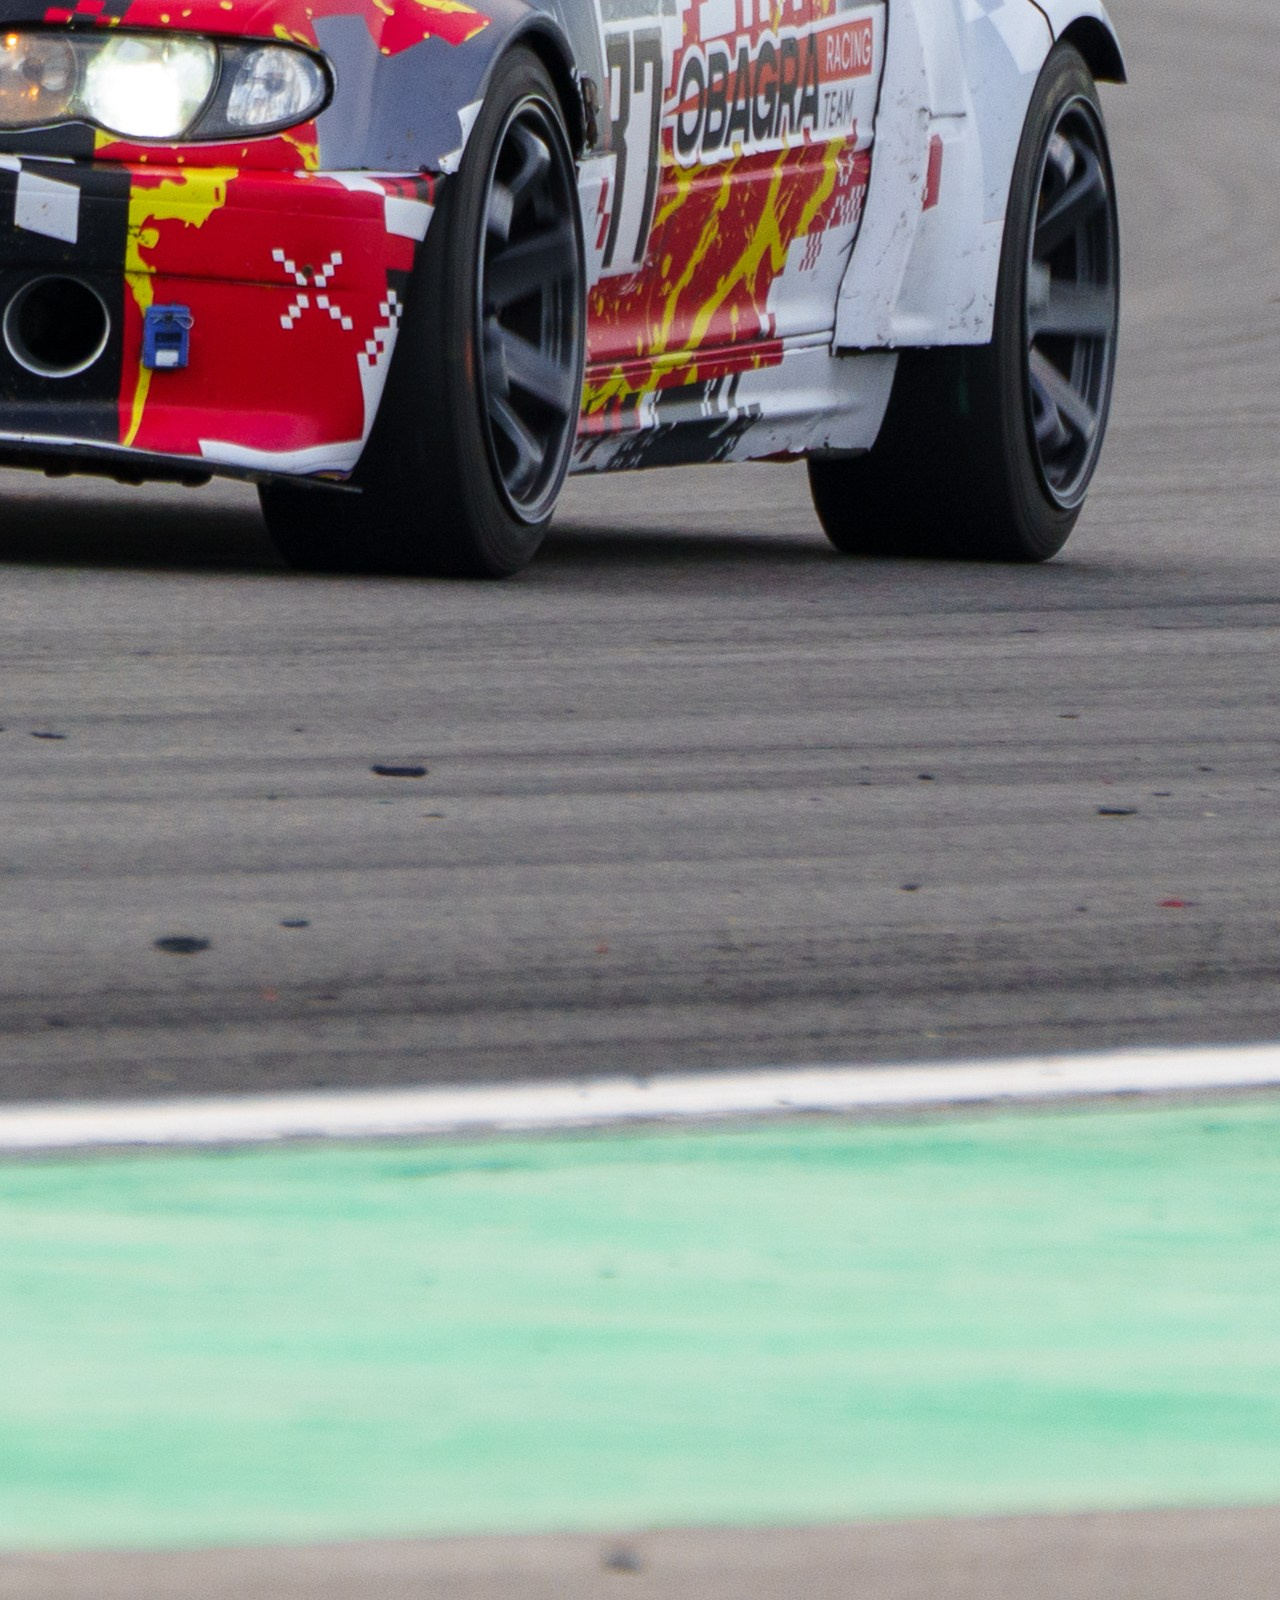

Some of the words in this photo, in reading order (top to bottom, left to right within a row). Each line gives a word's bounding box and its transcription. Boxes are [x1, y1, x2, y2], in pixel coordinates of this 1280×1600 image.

[825, 28, 871, 74] RACING
[676, 32, 819, 156] OBAGRA
[823, 89, 856, 129] TEAM
